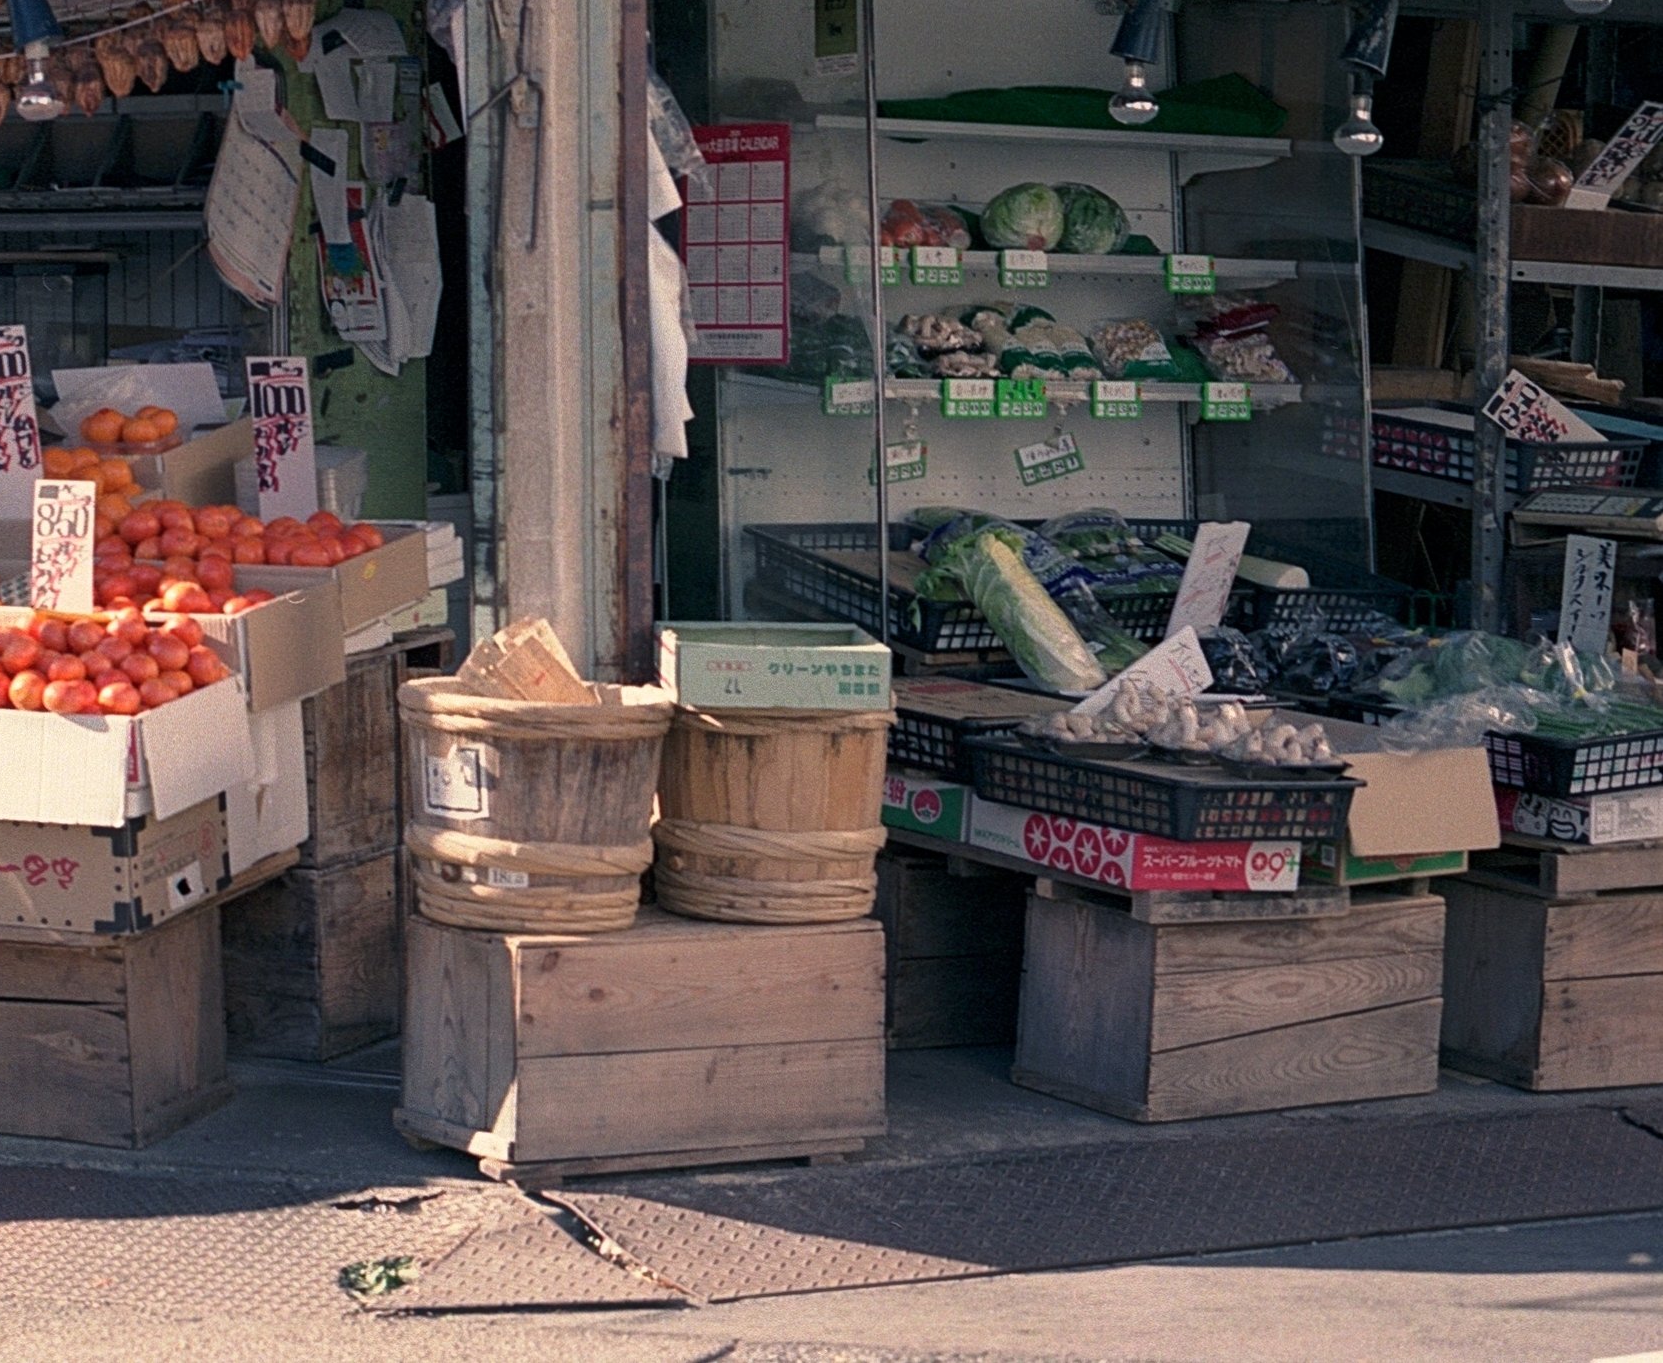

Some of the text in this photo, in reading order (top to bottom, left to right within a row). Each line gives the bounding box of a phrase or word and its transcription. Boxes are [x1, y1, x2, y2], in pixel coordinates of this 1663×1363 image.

[740, 136, 779, 151] CALENDAR
[253, 382, 307, 418] 1000
[37, 503, 89, 538] 850
[768, 662, 881, 677] クリーンやちまた
[1142, 855, 1242, 868] スーパーフルーツトマト
